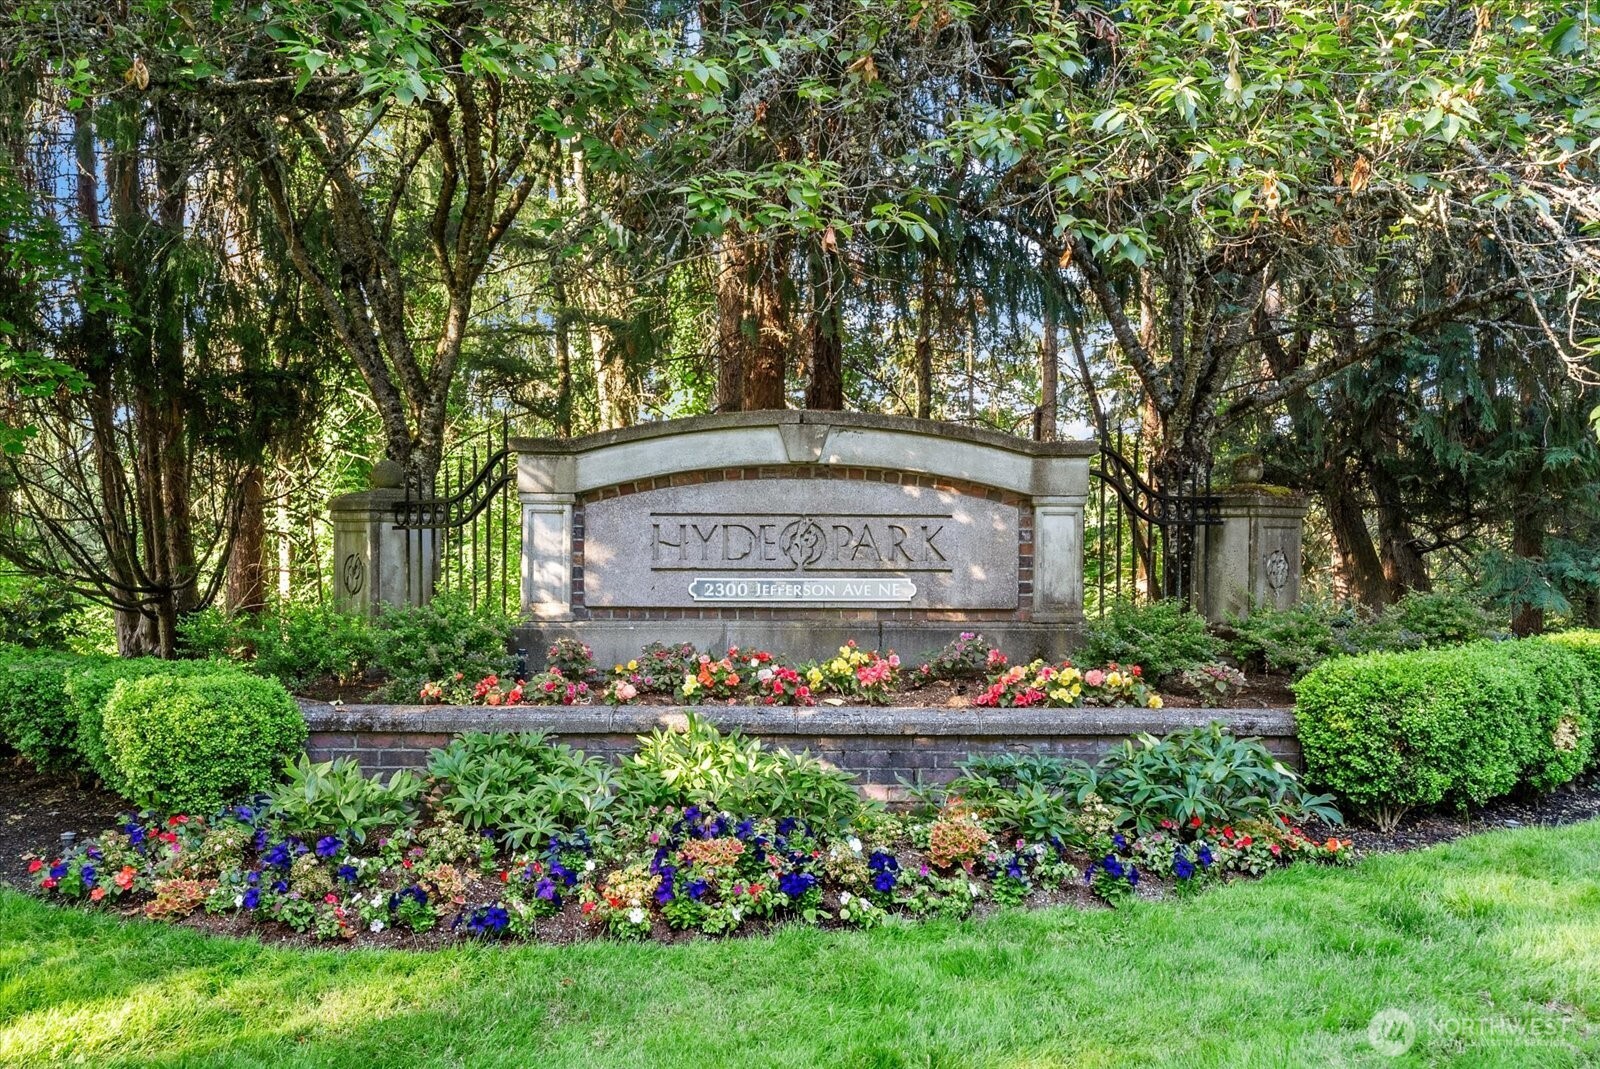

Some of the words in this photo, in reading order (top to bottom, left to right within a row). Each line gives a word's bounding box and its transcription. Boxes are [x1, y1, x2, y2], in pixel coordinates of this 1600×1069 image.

[651, 523, 776, 562] HYDE
[832, 523, 948, 562] PARK
[704, 583, 748, 597] 2300
[754, 582, 836, 597] JEFFERSON
[842, 583, 871, 597] AVE
[878, 583, 902, 597] NE
